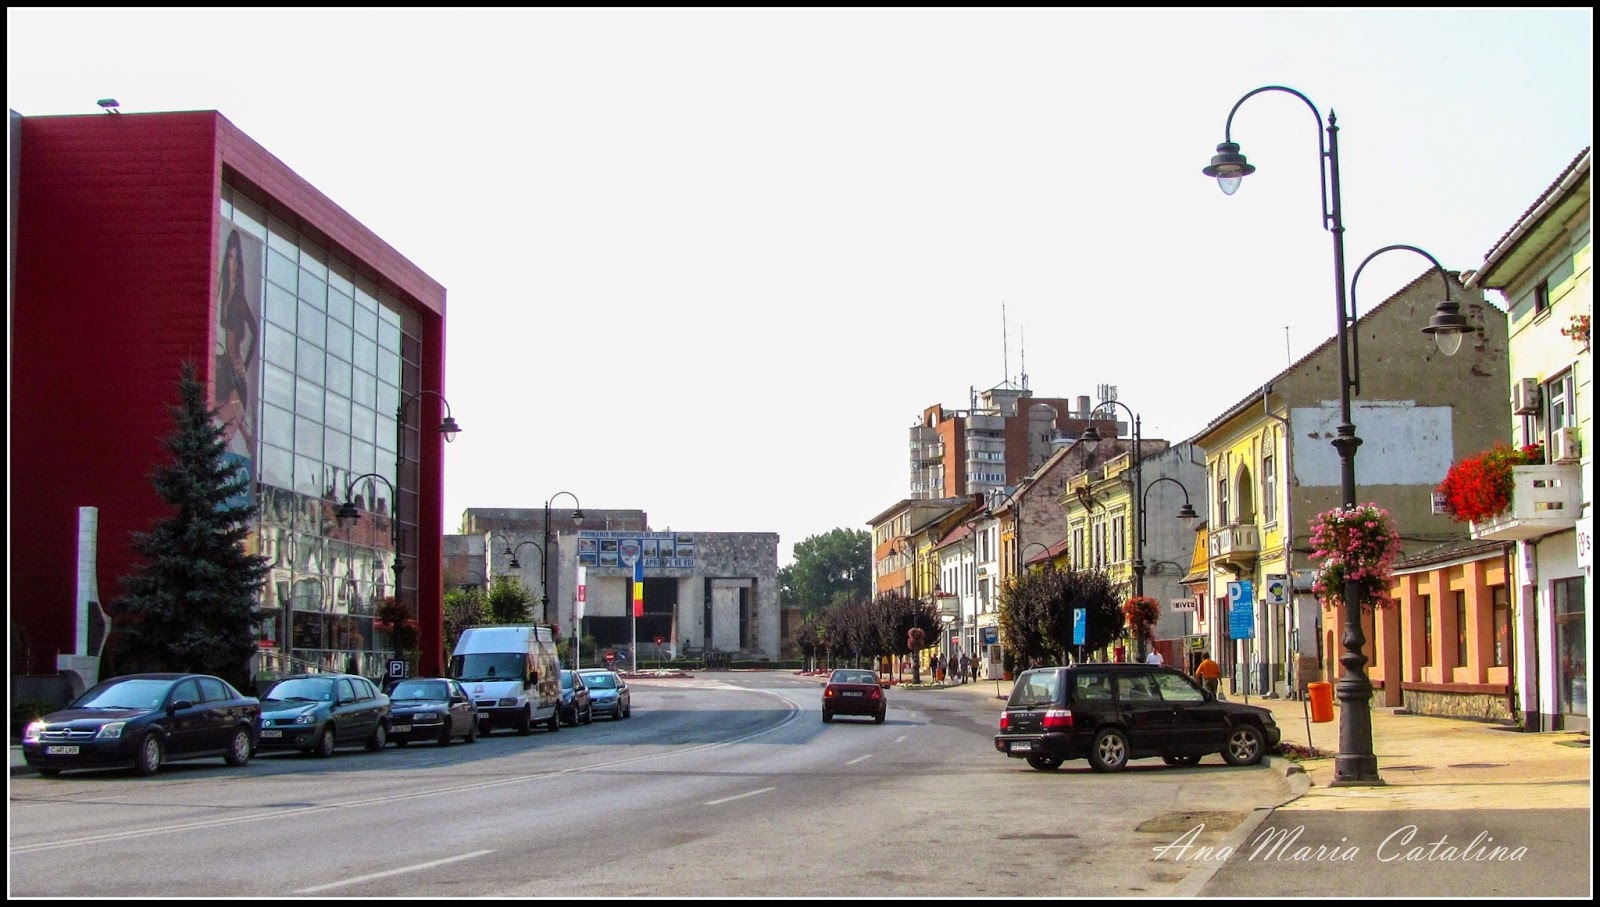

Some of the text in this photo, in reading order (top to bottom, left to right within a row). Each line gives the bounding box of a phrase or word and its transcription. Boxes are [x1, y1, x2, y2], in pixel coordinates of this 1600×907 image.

[674, 558, 683, 566] DE
[684, 558, 694, 566] VOI
[1228, 582, 1242, 612] P
[1073, 608, 1081, 628] P
[392, 663, 402, 675] P
